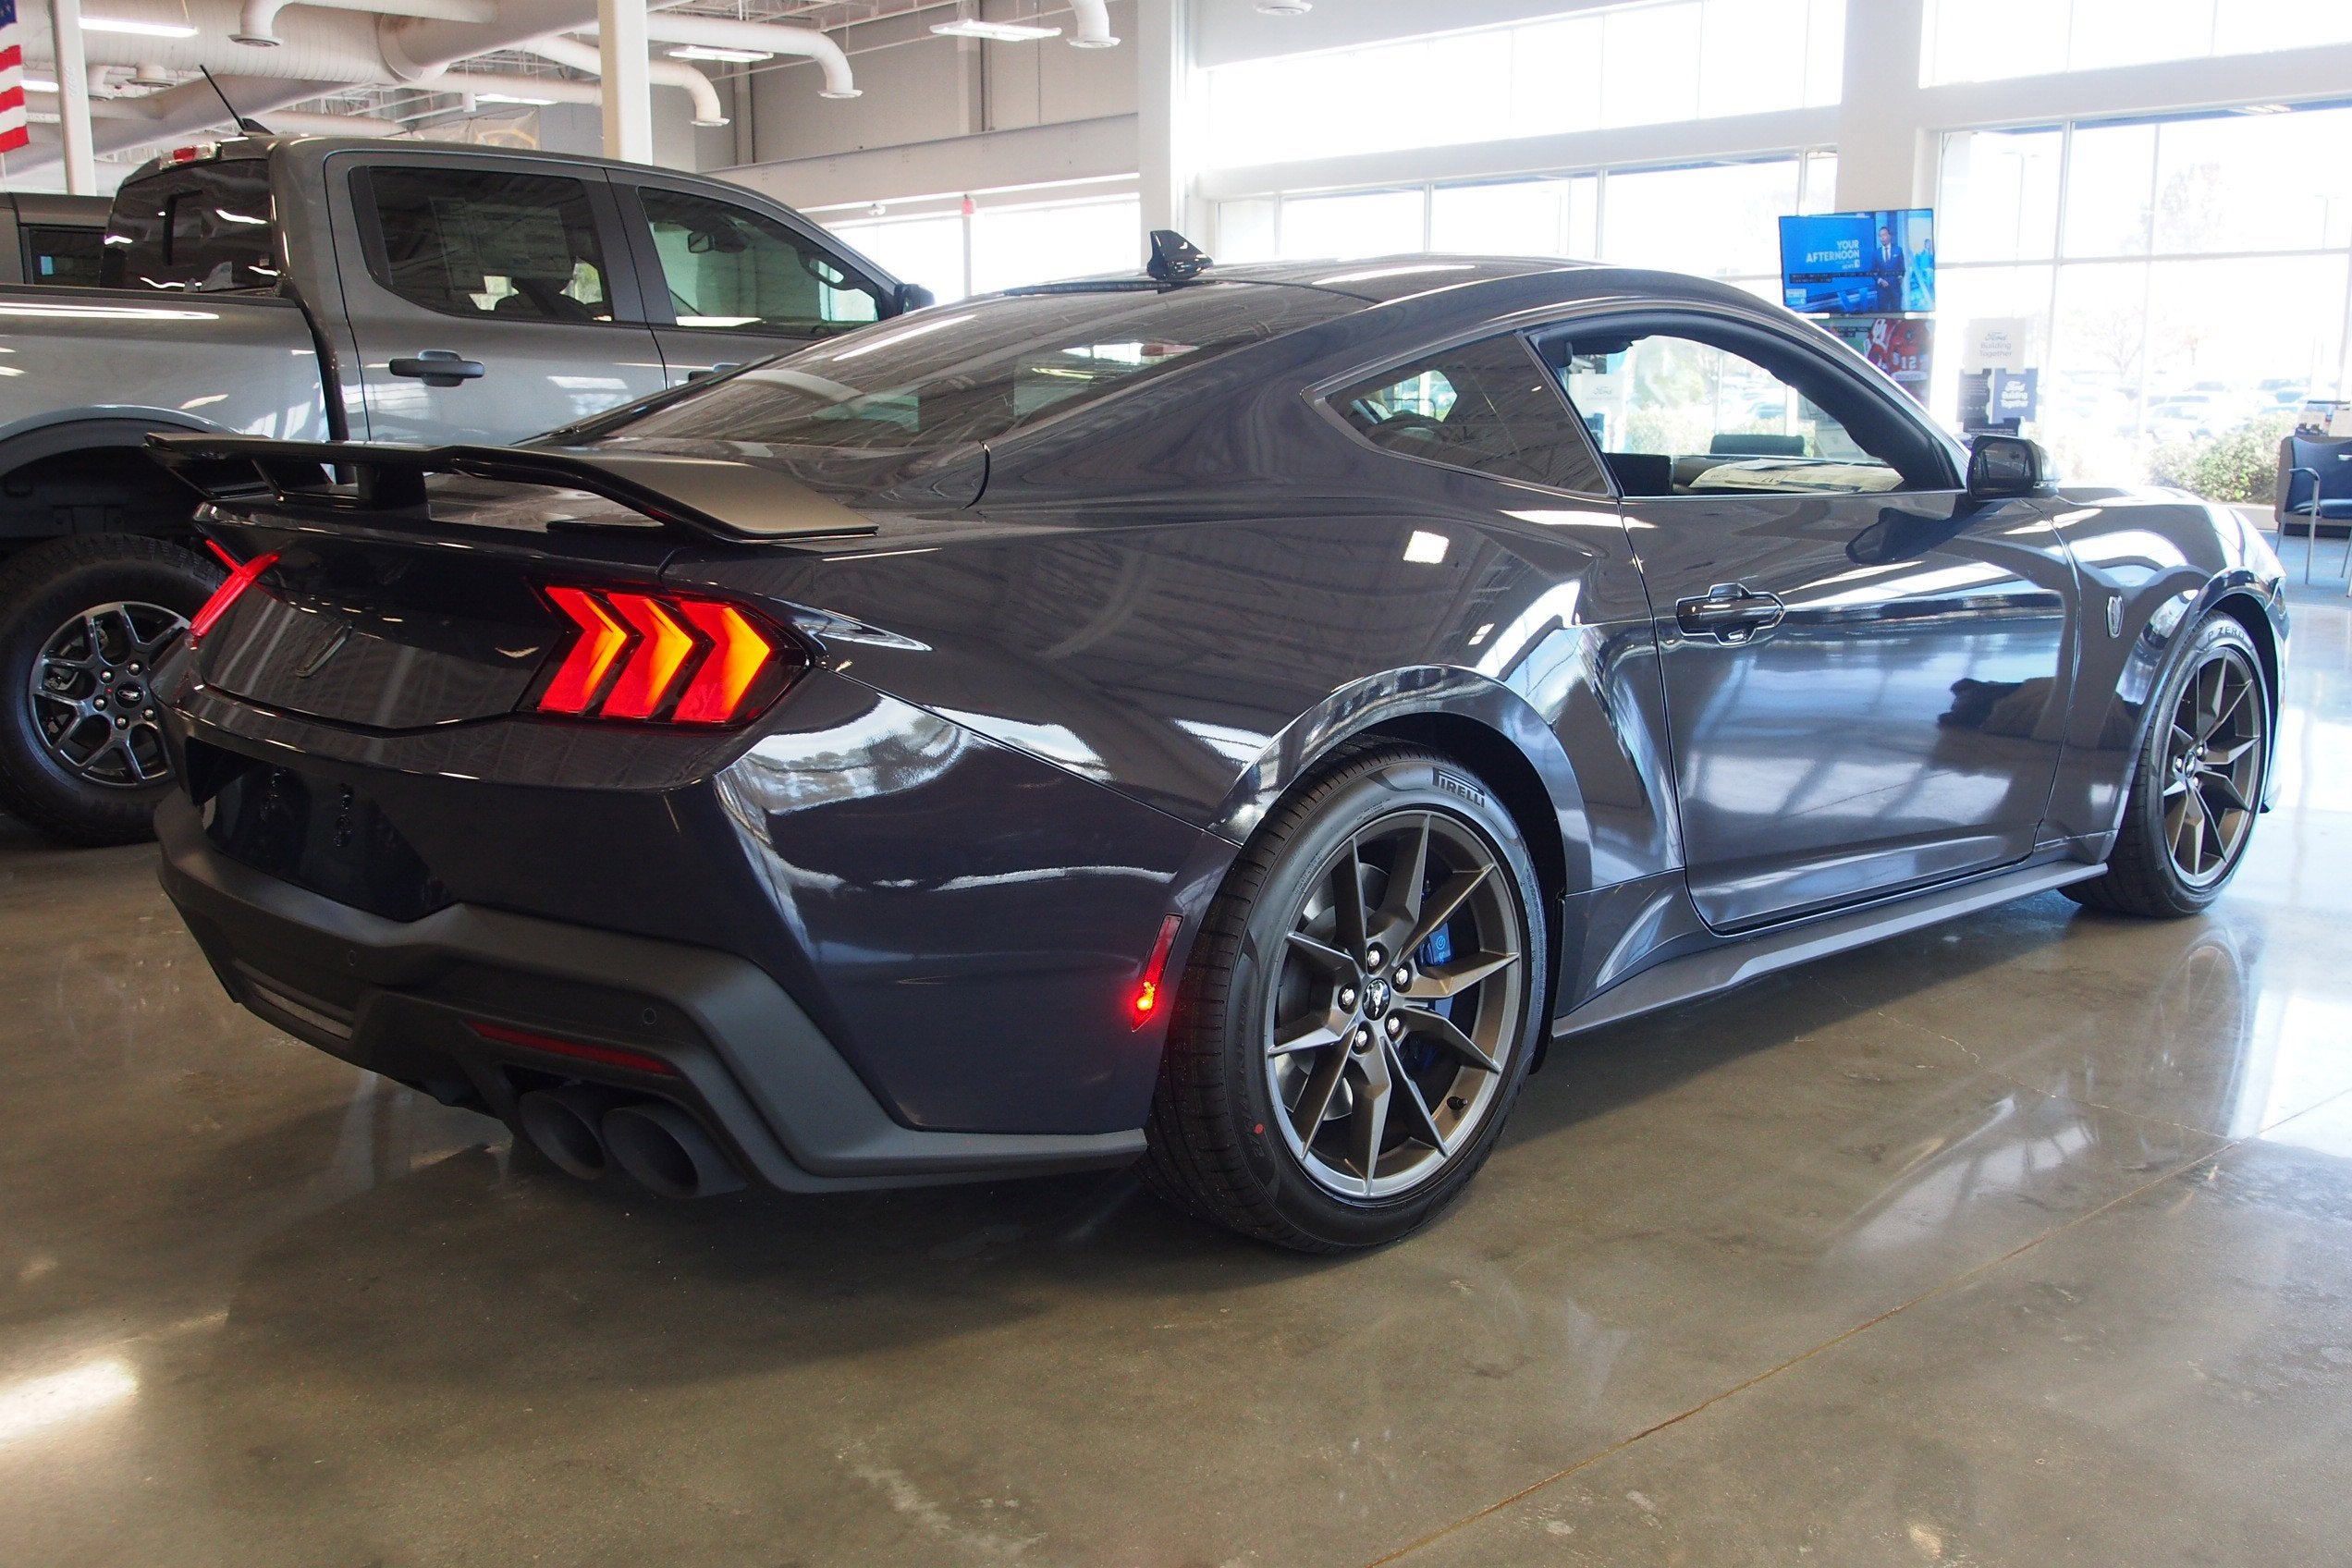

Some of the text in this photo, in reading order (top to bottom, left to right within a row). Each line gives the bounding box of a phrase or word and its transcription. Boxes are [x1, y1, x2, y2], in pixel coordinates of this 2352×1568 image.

[1836, 239, 1859, 250] YOUR
[1806, 249, 1860, 263] AFTERNOON
[1980, 341, 2012, 350] Building
[1979, 349, 2013, 359] Together
[1901, 355, 1917, 369] 12
[2001, 390, 2028, 400] Building
[2207, 626, 2245, 642] P ZERO
[1432, 766, 1485, 808] PIRELLI
